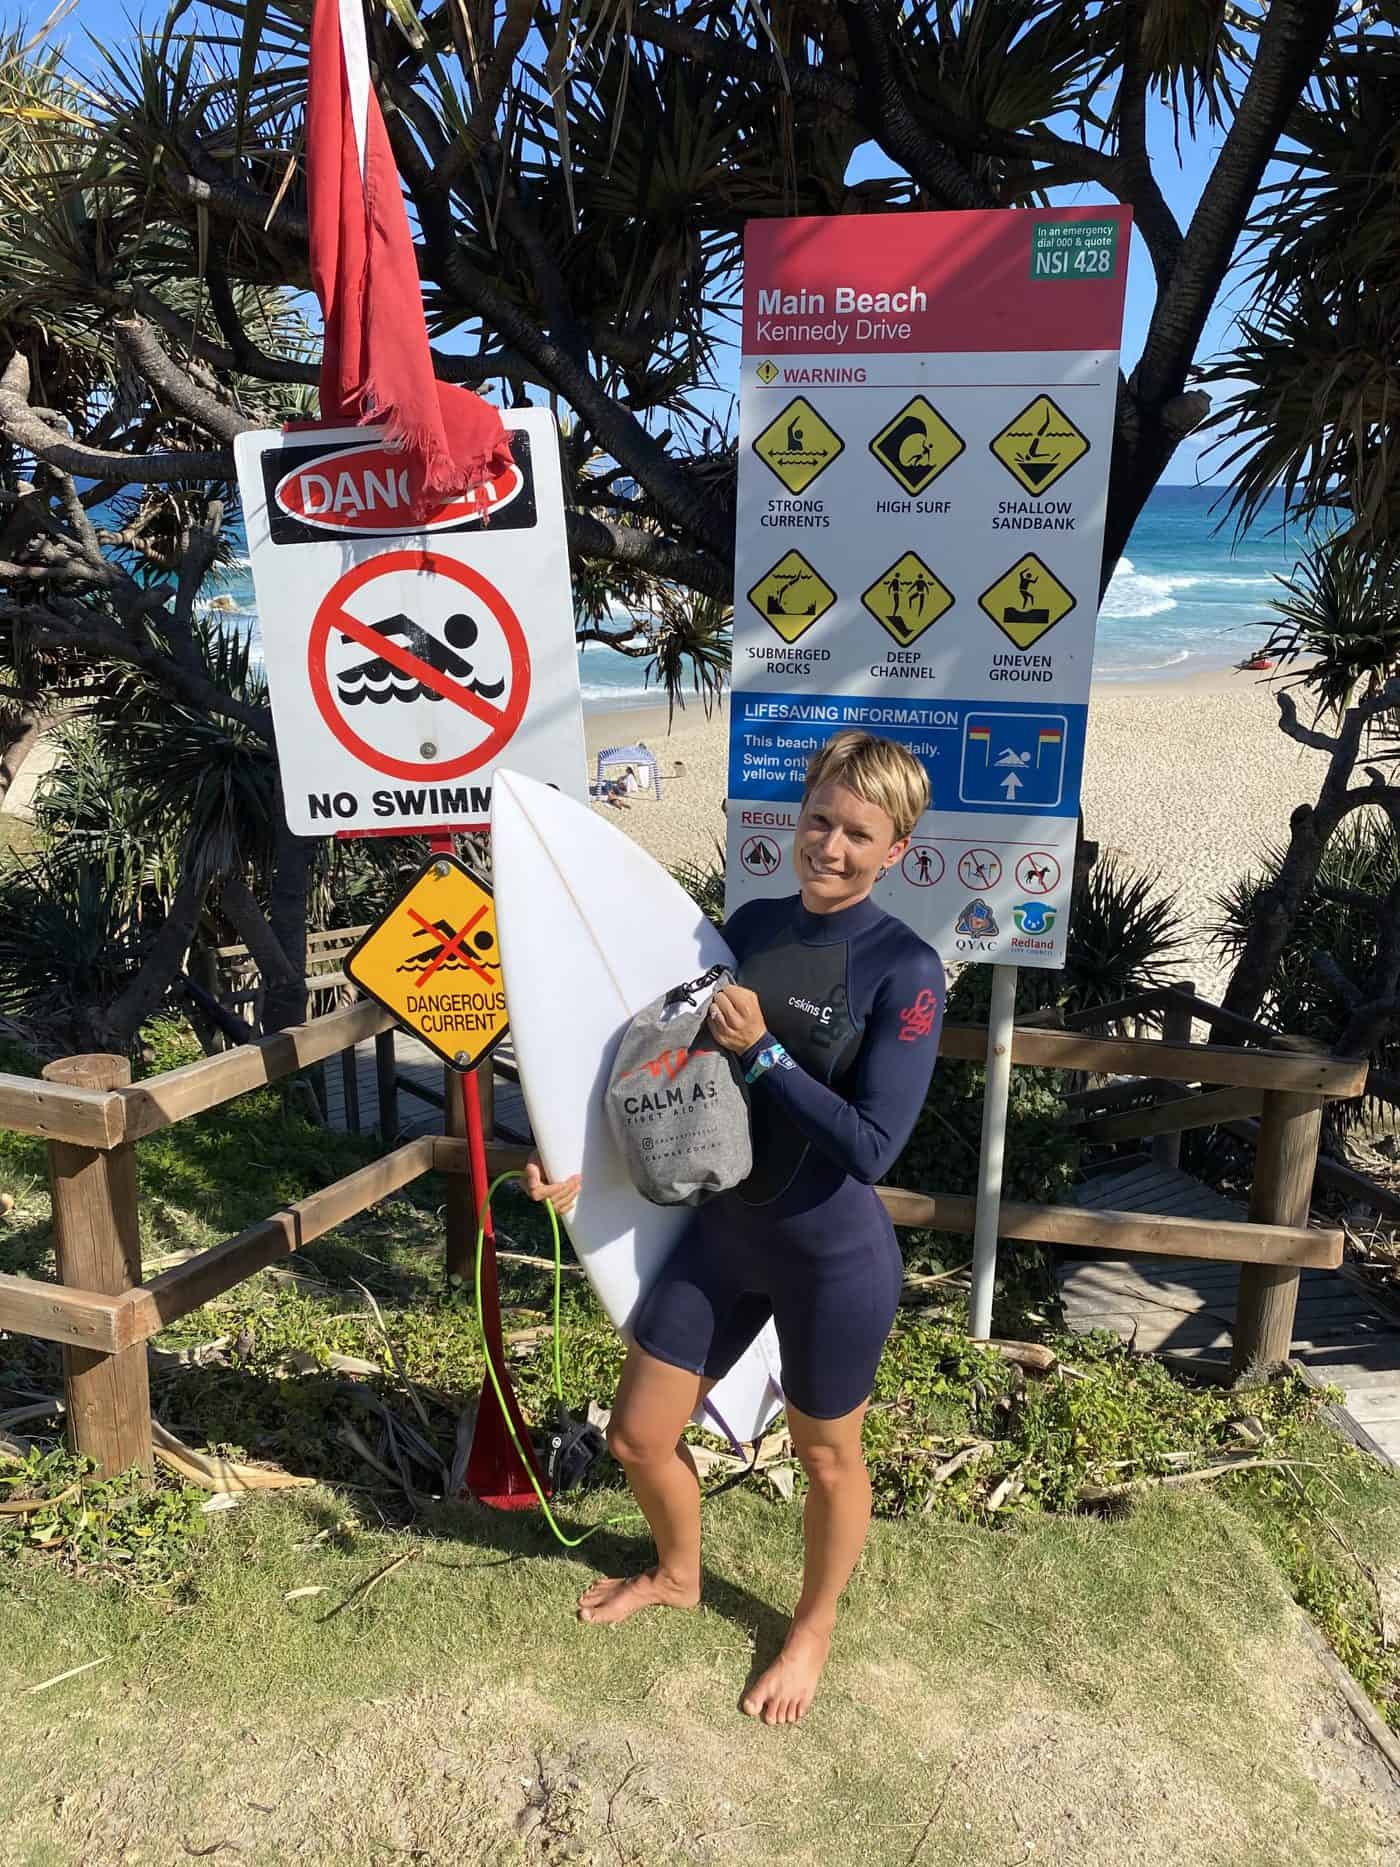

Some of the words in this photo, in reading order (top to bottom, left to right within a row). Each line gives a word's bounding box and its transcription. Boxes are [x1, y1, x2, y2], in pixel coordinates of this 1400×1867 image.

[1038, 227, 1047, 236] In
[1049, 228, 1060, 236] an
[1062, 226, 1113, 237] emergency
[1037, 238, 1053, 248] dial
[1056, 238, 1073, 247] 000
[1075, 238, 1082, 246] &
[1084, 237, 1112, 248] quote
[1036, 250, 1069, 274] NSI
[1074, 249, 1111, 273] 428
[758, 288, 825, 315] Main
[835, 286, 927, 314] Beach
[757, 321, 849, 346] Kennedy
[856, 318, 912, 340] Drive
[783, 367, 867, 383] WARNING
[768, 499, 824, 513] STRONG
[876, 500, 912, 513] HIGH
[916, 501, 952, 514] SURF
[998, 501, 1072, 515] SHALLOW
[760, 514, 830, 528] CURRENTS
[992, 516, 1076, 530] SANDBANK
[748, 647, 831, 661] SUBMERGED
[886, 651, 921, 664] DEEP
[992, 654, 1052, 668] UNEVEN
[767, 661, 811, 675] ROCKS
[870, 665, 936, 680] CHANNEL
[989, 668, 1053, 683] GROUND
[744, 703, 839, 721] LIFESAVING
[842, 707, 959, 726] INFORMATION
[743, 734, 773, 748] This
[776, 737, 817, 749] beach
[743, 753, 780, 766] Swim
[742, 768, 785, 782] yellow
[789, 770, 808, 782] fla
[308, 791, 358, 819] NO
[955, 939, 998, 952] QYAC
[1011, 937, 1054, 950] Redland
[407, 992, 506, 1012] DANGEROUS
[420, 1013, 497, 1033] CURRENT
[624, 1087, 684, 1115] CALM
